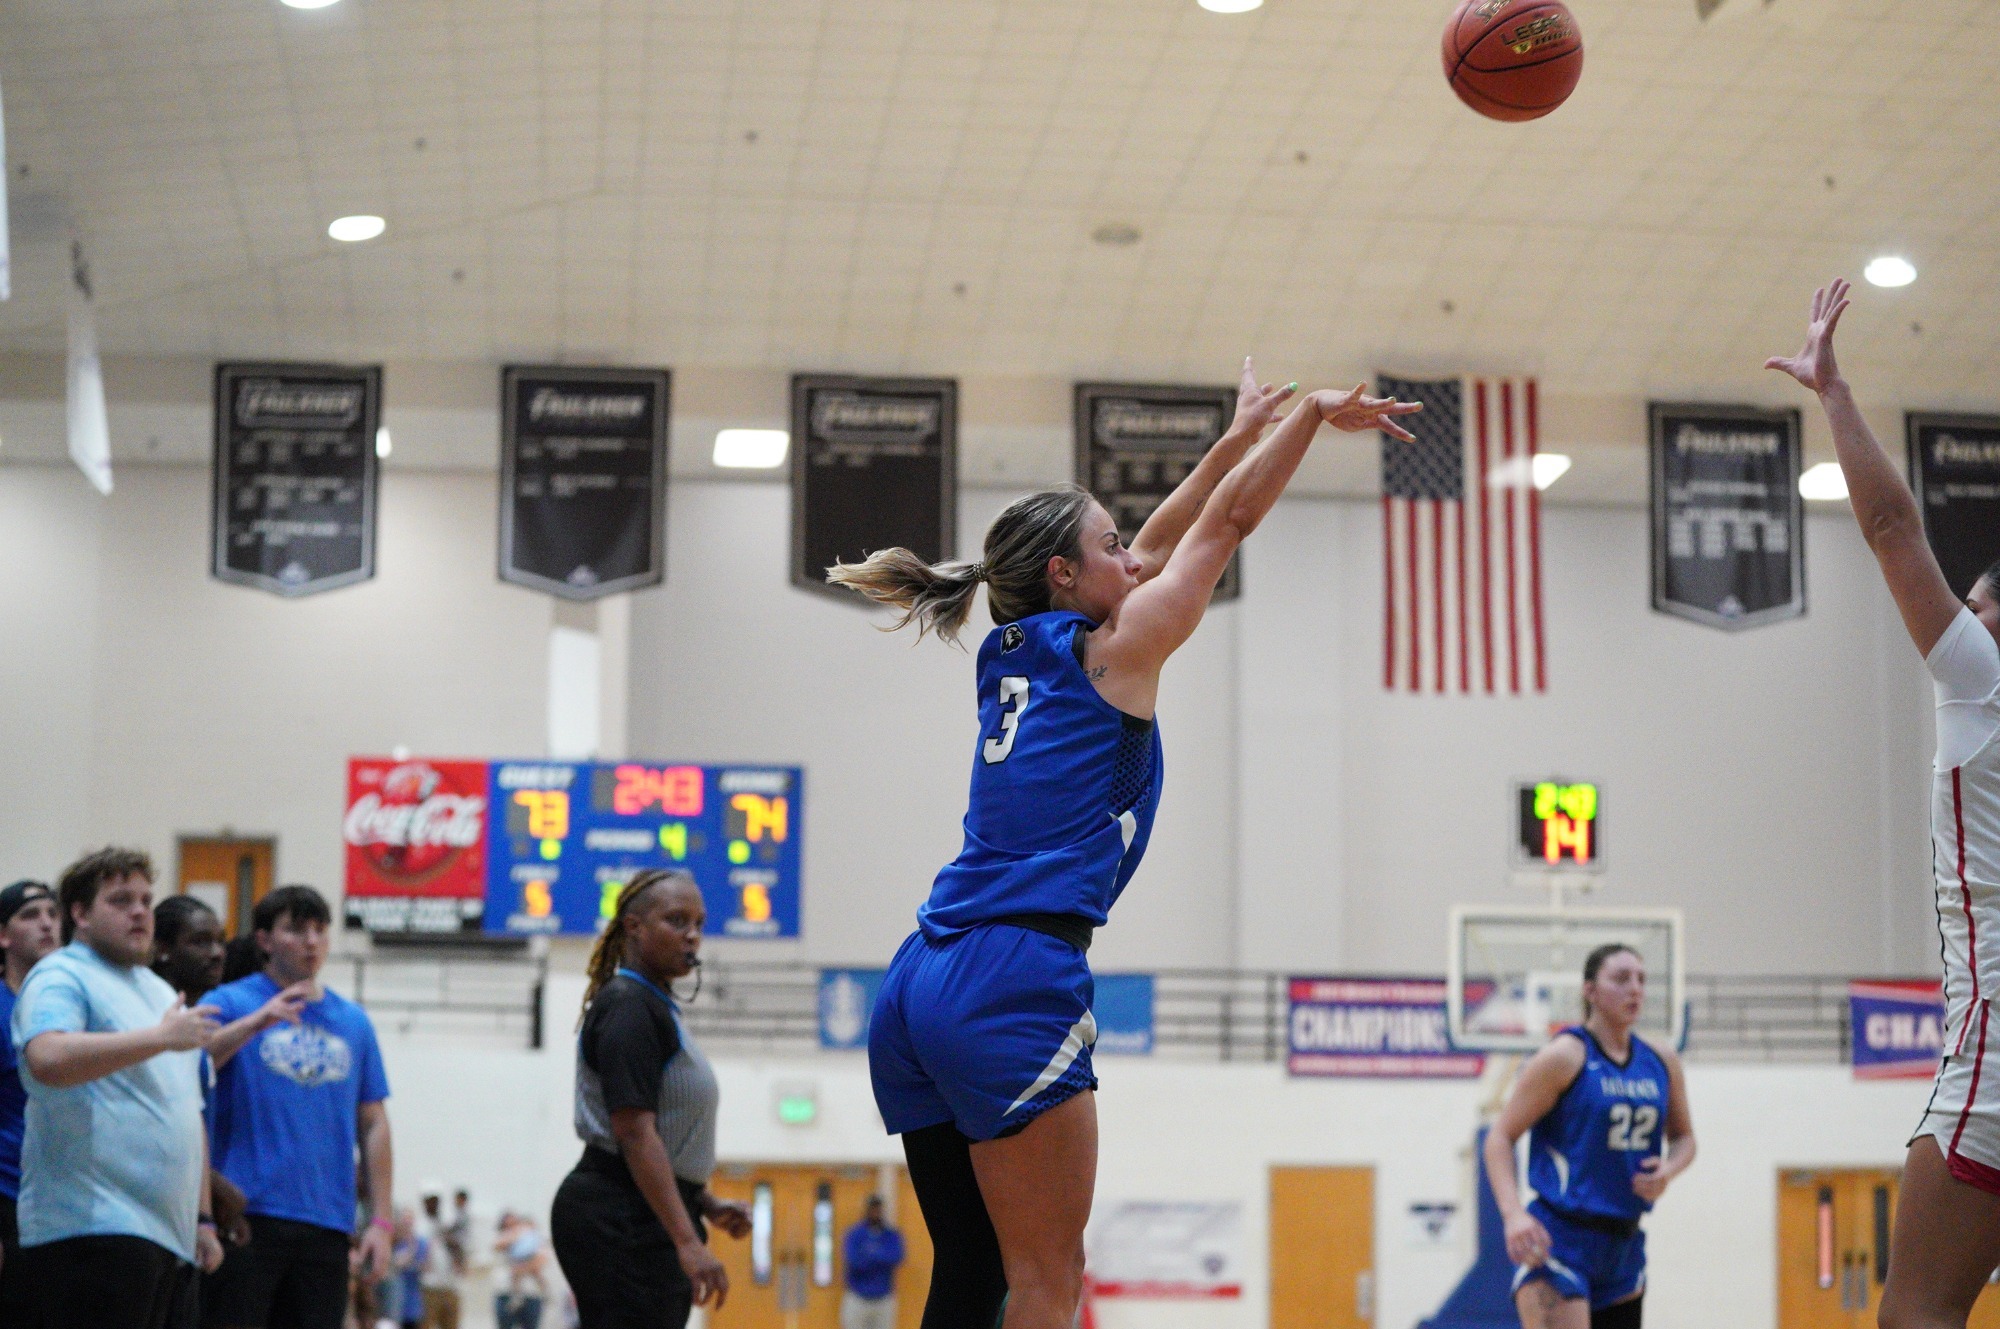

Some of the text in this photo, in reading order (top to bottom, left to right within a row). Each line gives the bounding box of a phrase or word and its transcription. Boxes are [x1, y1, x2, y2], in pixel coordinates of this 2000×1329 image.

[982, 675, 1029, 765] 3
[513, 789, 570, 840] 73
[730, 793, 788, 843] 74
[1543, 812, 1589, 865] 14
[659, 822, 687, 861] 4
[1866, 1012, 1946, 1050] CHA
[1607, 1102, 1659, 1152] 22
